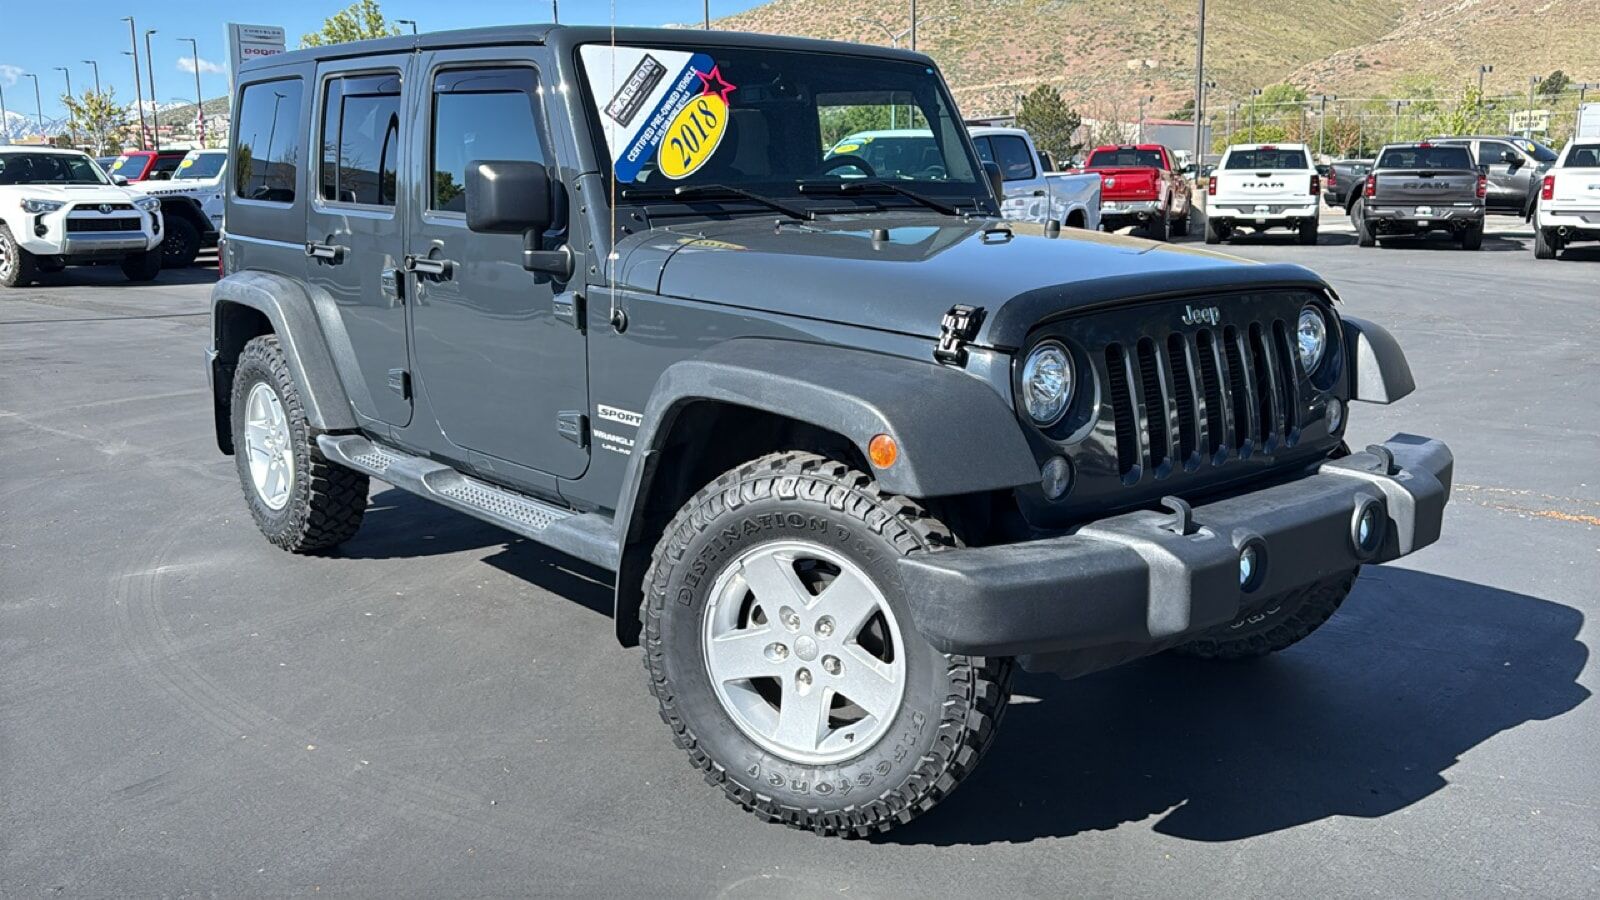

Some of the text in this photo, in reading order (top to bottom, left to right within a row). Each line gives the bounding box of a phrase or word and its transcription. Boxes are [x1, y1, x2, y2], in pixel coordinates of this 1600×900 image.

[610, 60, 655, 117] CARSON
[627, 127, 654, 162] CERTIFIED
[651, 91, 680, 129] PRE-OWNED
[676, 66, 697, 92] VEHICLE
[671, 99, 717, 169] 2018
[1181, 304, 1220, 326] Jeep
[600, 408, 641, 424] SPORT
[677, 512, 829, 607] DESTINATION
